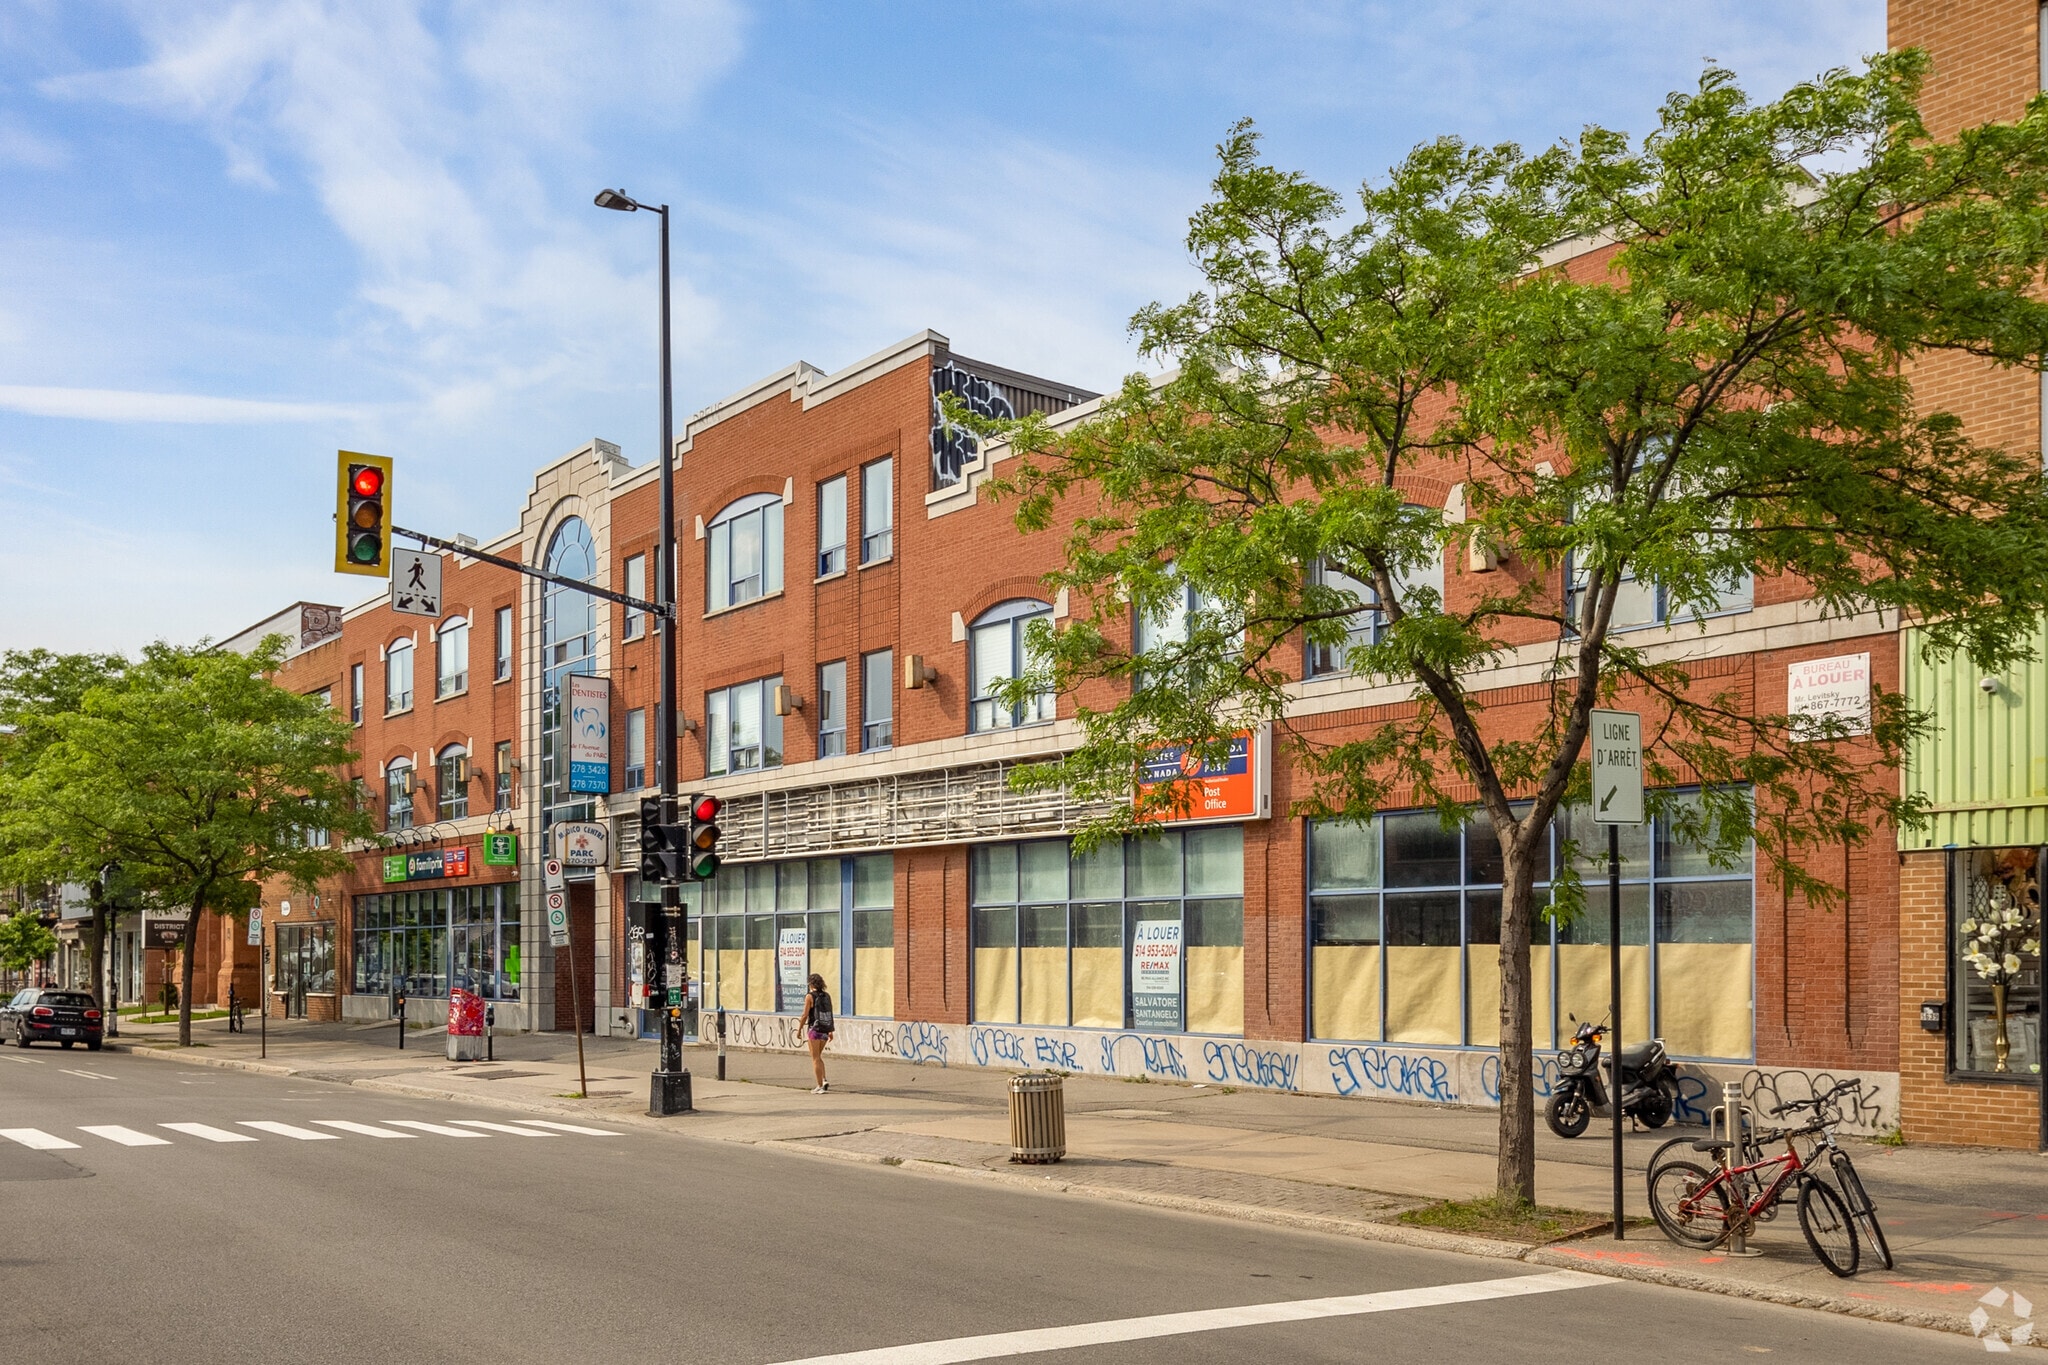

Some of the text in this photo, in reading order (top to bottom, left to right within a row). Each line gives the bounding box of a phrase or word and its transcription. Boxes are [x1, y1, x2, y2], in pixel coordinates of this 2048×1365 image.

[1803, 660, 1850, 675] BUREAU
[1793, 669, 1865, 690] À LOUER
[572, 688, 608, 699] DENTISTES
[1808, 691, 1840, 701] Levitsky
[1810, 695, 1861, 711] 867-7772
[1603, 723, 1630, 741] LIGNE
[1597, 747, 1637, 767] D'ARRÊT
[571, 764, 606, 775] 278 3428
[572, 779, 606, 790] 278 7370
[1204, 786, 1220, 798] Post
[1204, 799, 1227, 810] Office
[558, 825, 605, 841] MDICO CENTRE
[570, 849, 594, 857] PARC
[786, 933, 806, 944] LOUER
[1147, 926, 1179, 940] LOUER
[1135, 944, 1178, 957] 514 953-5204
[1140, 961, 1170, 970] RE/MAX
[1135, 997, 1178, 1008] SALVATORE
[1135, 1009, 1179, 1019] SANTANGELO
